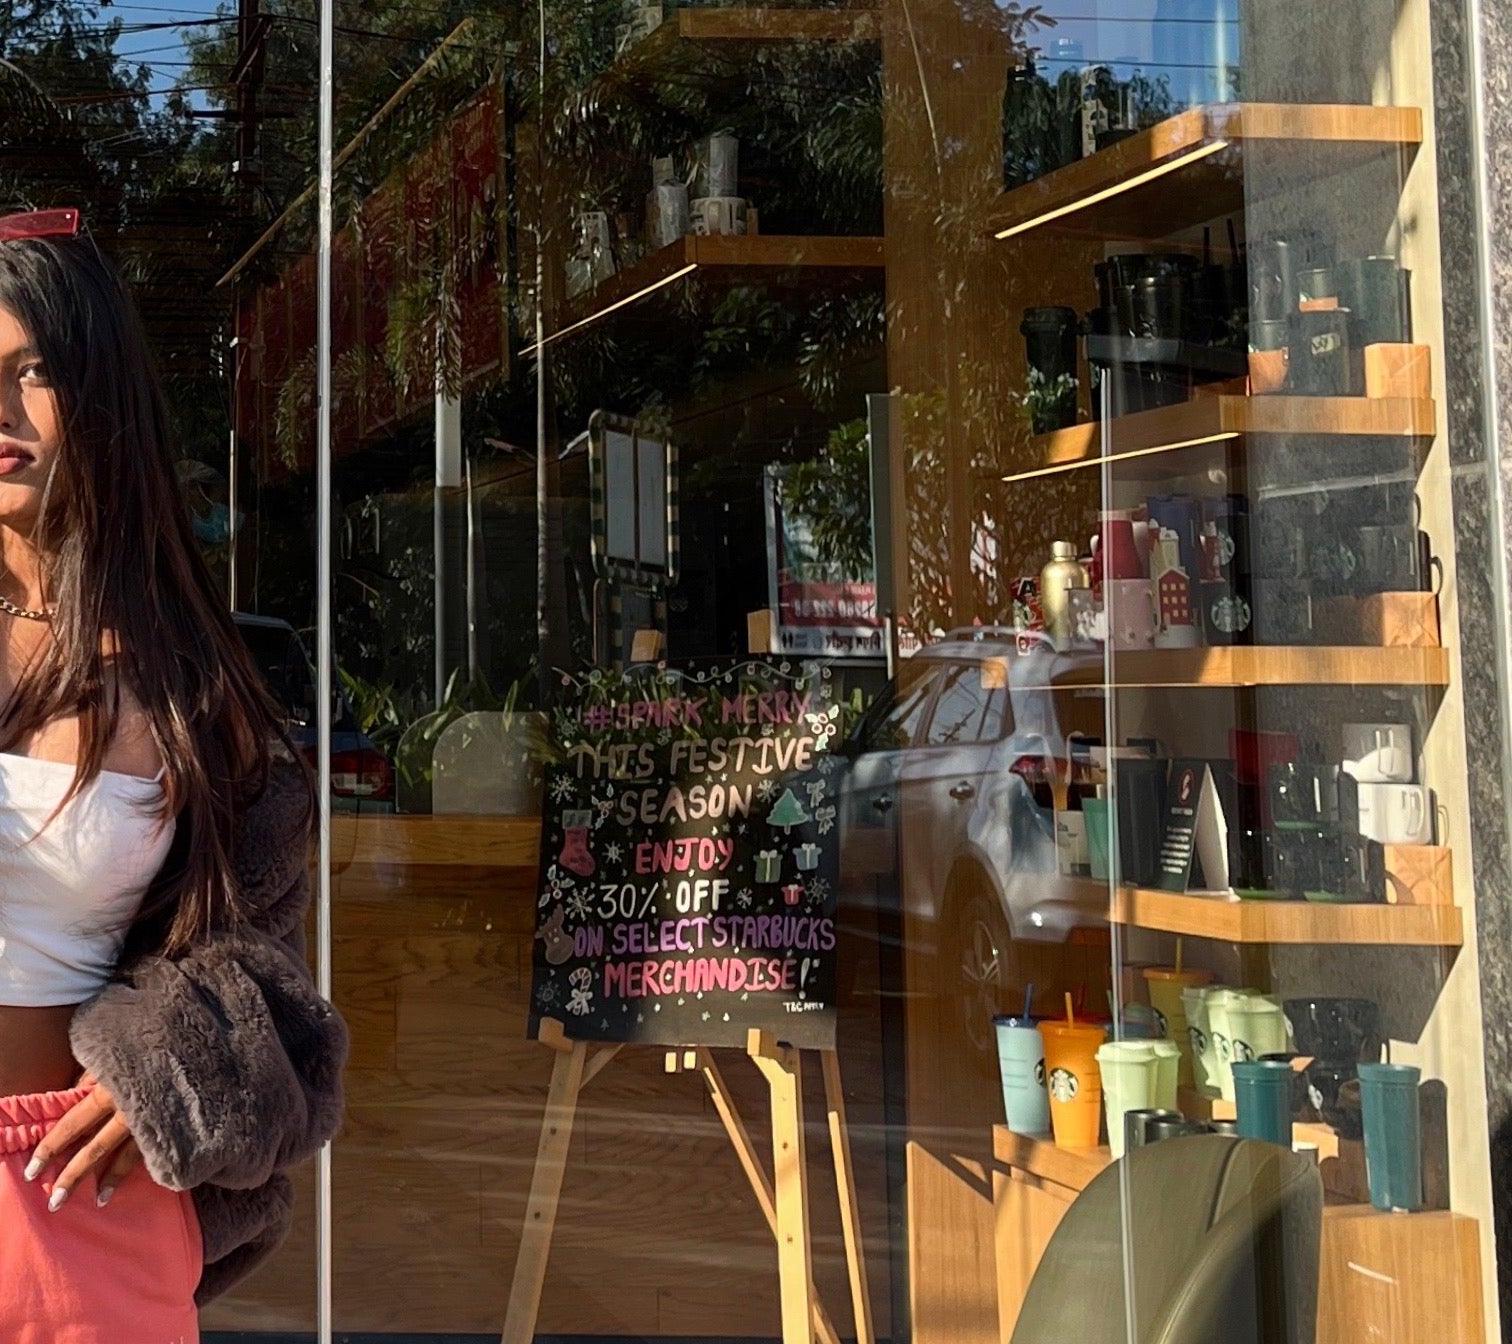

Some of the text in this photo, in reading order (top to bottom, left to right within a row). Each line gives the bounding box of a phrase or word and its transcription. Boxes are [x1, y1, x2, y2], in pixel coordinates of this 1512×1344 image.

[584, 690, 814, 732] #SPARK MERRY
[567, 737, 815, 779] THIS FESTIVE
[616, 783, 753, 826] SEASON
[635, 837, 734, 874] ENJOY
[597, 879, 730, 919] 30% OFF
[573, 914, 836, 958] ON SELECT STARBUCKS
[604, 957, 810, 1000] MERCHANDISE!
